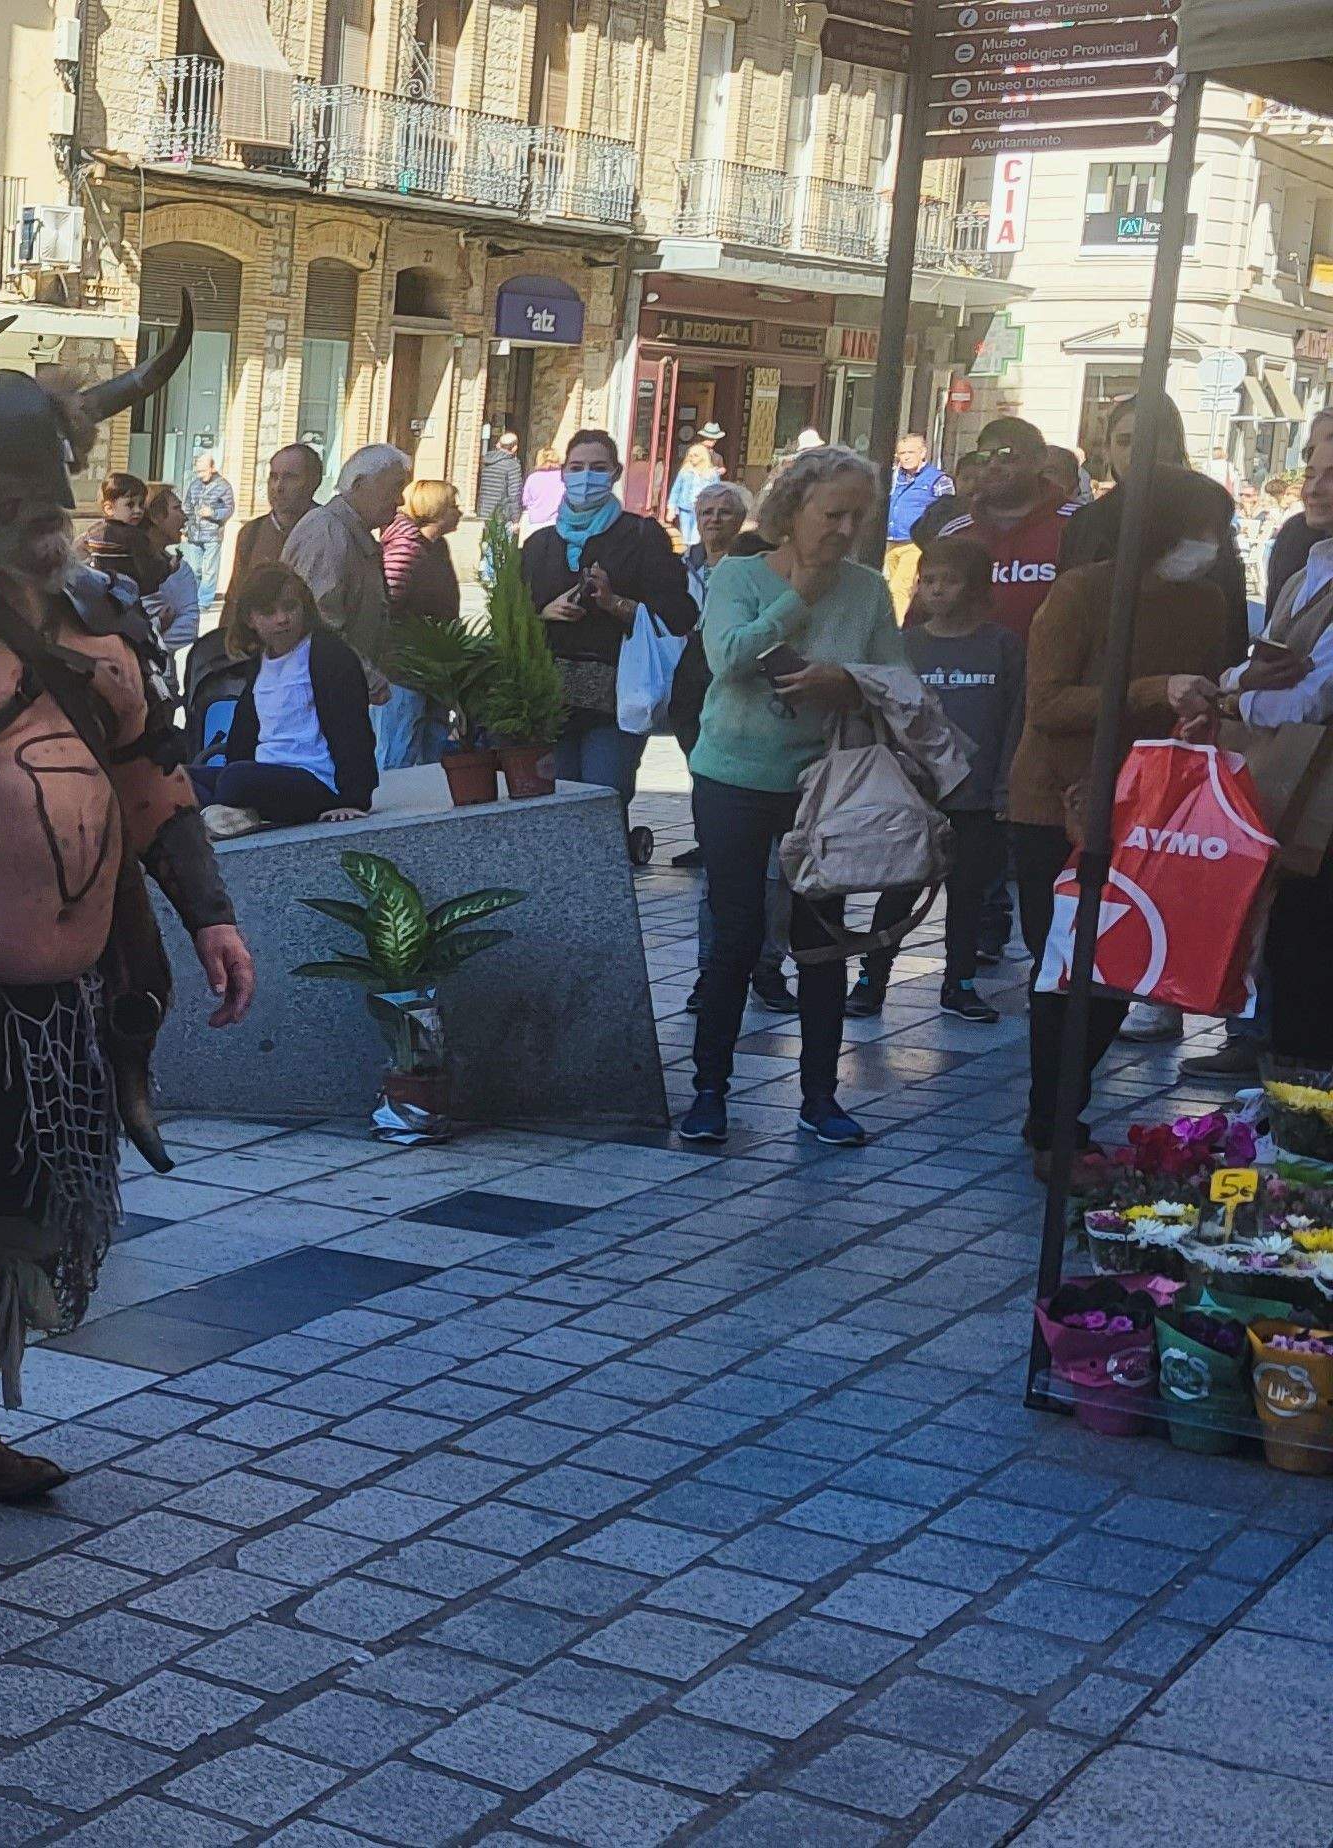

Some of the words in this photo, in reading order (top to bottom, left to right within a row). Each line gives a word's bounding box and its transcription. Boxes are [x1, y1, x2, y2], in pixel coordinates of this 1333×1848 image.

[985, 8, 1032, 21] Oficina
[1035, 6, 1052, 18] de
[1055, 3, 1108, 16] Turismo
[980, 46, 1068, 63] Arqueológico
[1072, 41, 1139, 56] Provincial
[982, 38, 1027, 50] Museo
[977, 80, 1021, 93] Museo
[1025, 75, 1096, 89] Diocesano
[974, 109, 1030, 121] Catedral
[971, 135, 1061, 151] Ayuntamiento
[1122, 826, 1229, 860] AYMO
